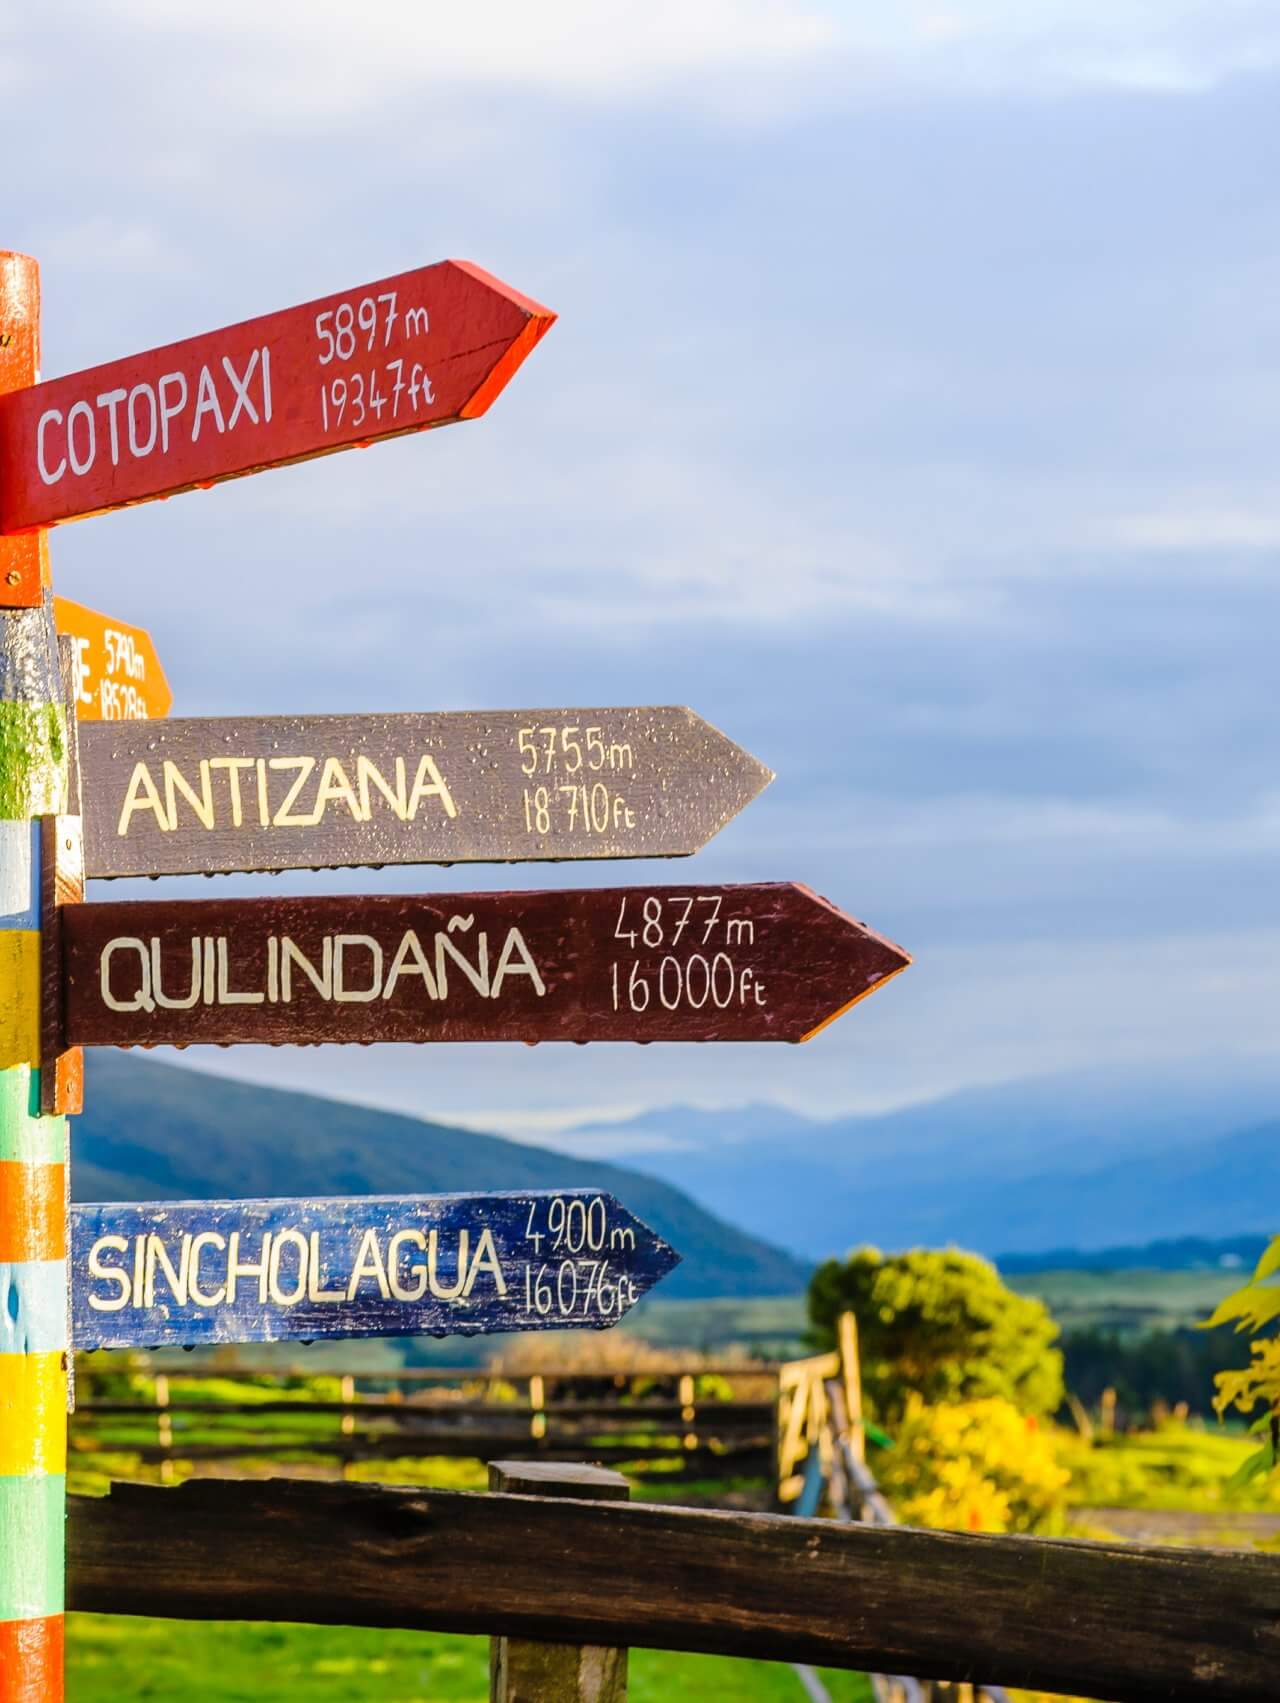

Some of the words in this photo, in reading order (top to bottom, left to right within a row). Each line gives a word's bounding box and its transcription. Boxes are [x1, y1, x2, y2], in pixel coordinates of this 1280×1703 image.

[315, 291, 430, 365] 5897m
[37, 346, 272, 485] COTOPAXI
[321, 358, 436, 432] 19347ft
[518, 726, 633, 775] 5755m
[117, 754, 458, 836] ANTIZANA
[613, 895, 754, 949] 4877m
[100, 913, 547, 1014] QUILINDAÑA
[525, 1196, 635, 1254] 4900m
[87, 1227, 507, 1312] SINCHOLAGUA
